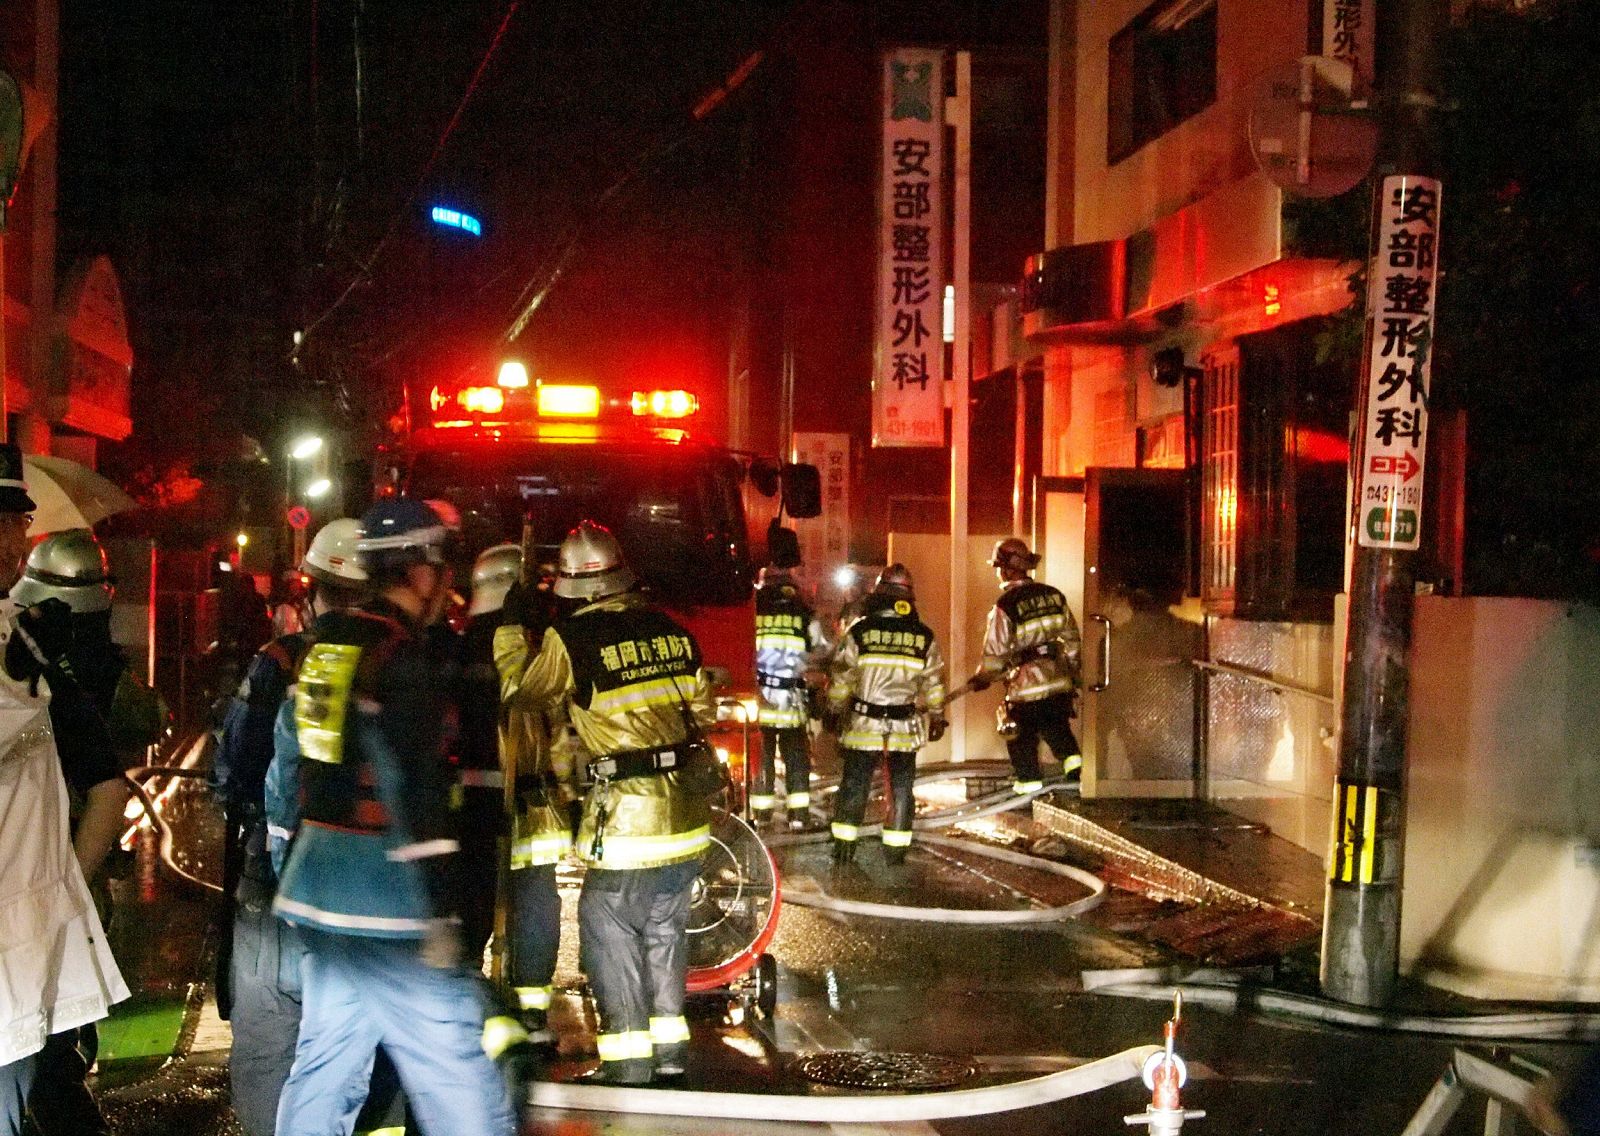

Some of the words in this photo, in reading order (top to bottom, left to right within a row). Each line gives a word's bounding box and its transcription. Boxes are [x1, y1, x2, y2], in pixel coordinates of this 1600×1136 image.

[892, 138, 930, 391] 安部整形外科
[1375, 185, 1436, 448] 安部整形外科
[1375, 458, 1409, 472] ココ
